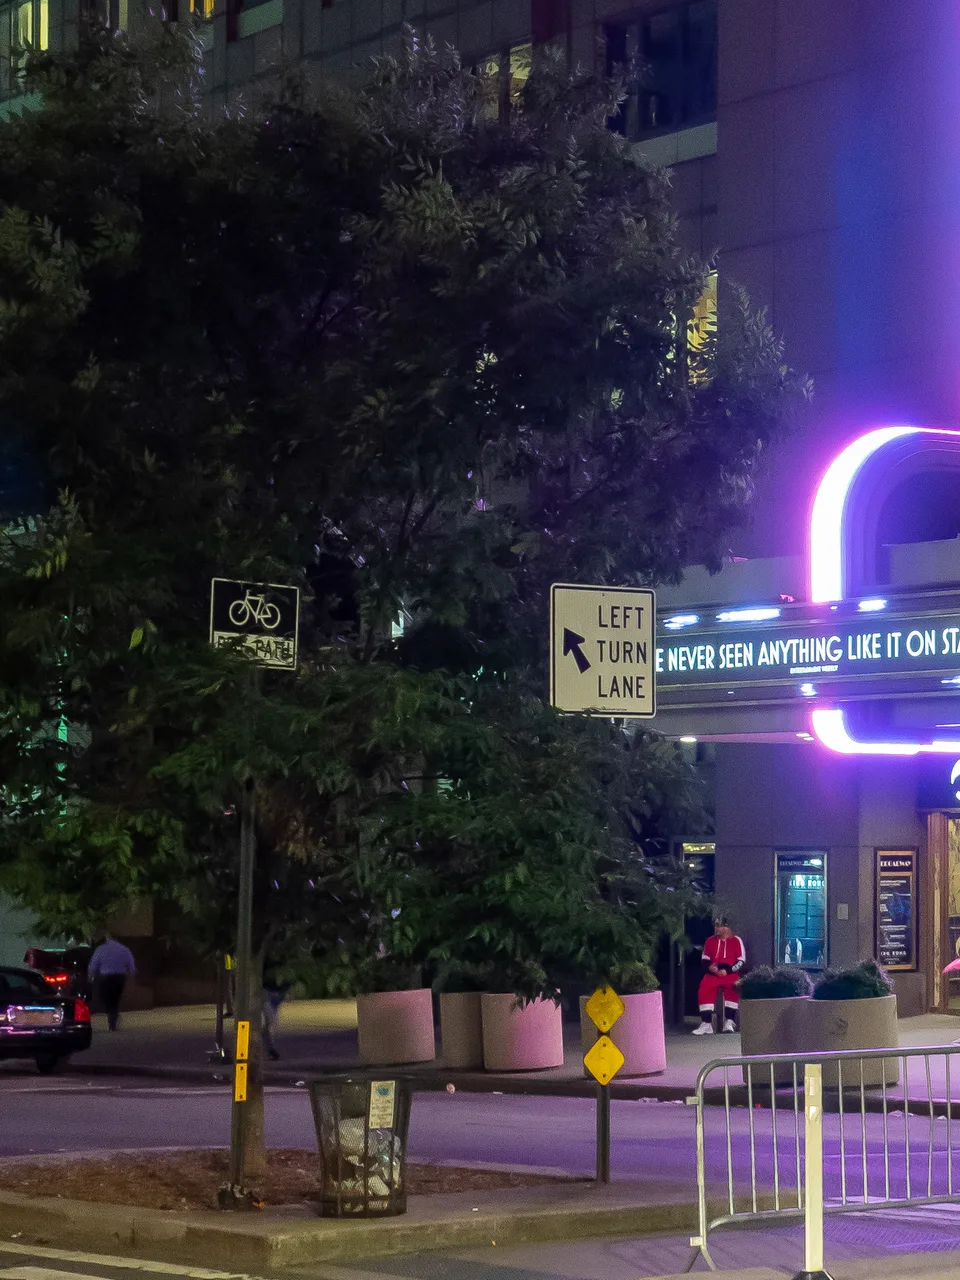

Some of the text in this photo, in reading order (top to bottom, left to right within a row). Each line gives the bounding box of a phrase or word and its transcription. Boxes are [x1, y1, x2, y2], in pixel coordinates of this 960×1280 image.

[598, 605, 644, 629] LEFT
[597, 640, 647, 664] TURN
[668, 644, 715, 672] NEVER
[719, 642, 753, 669] SEEN
[757, 635, 843, 666] ANYTHING
[848, 632, 882, 660] LIKE
[887, 632, 902, 658] IT
[906, 629, 936, 657] ON
[598, 675, 645, 698] LANE
